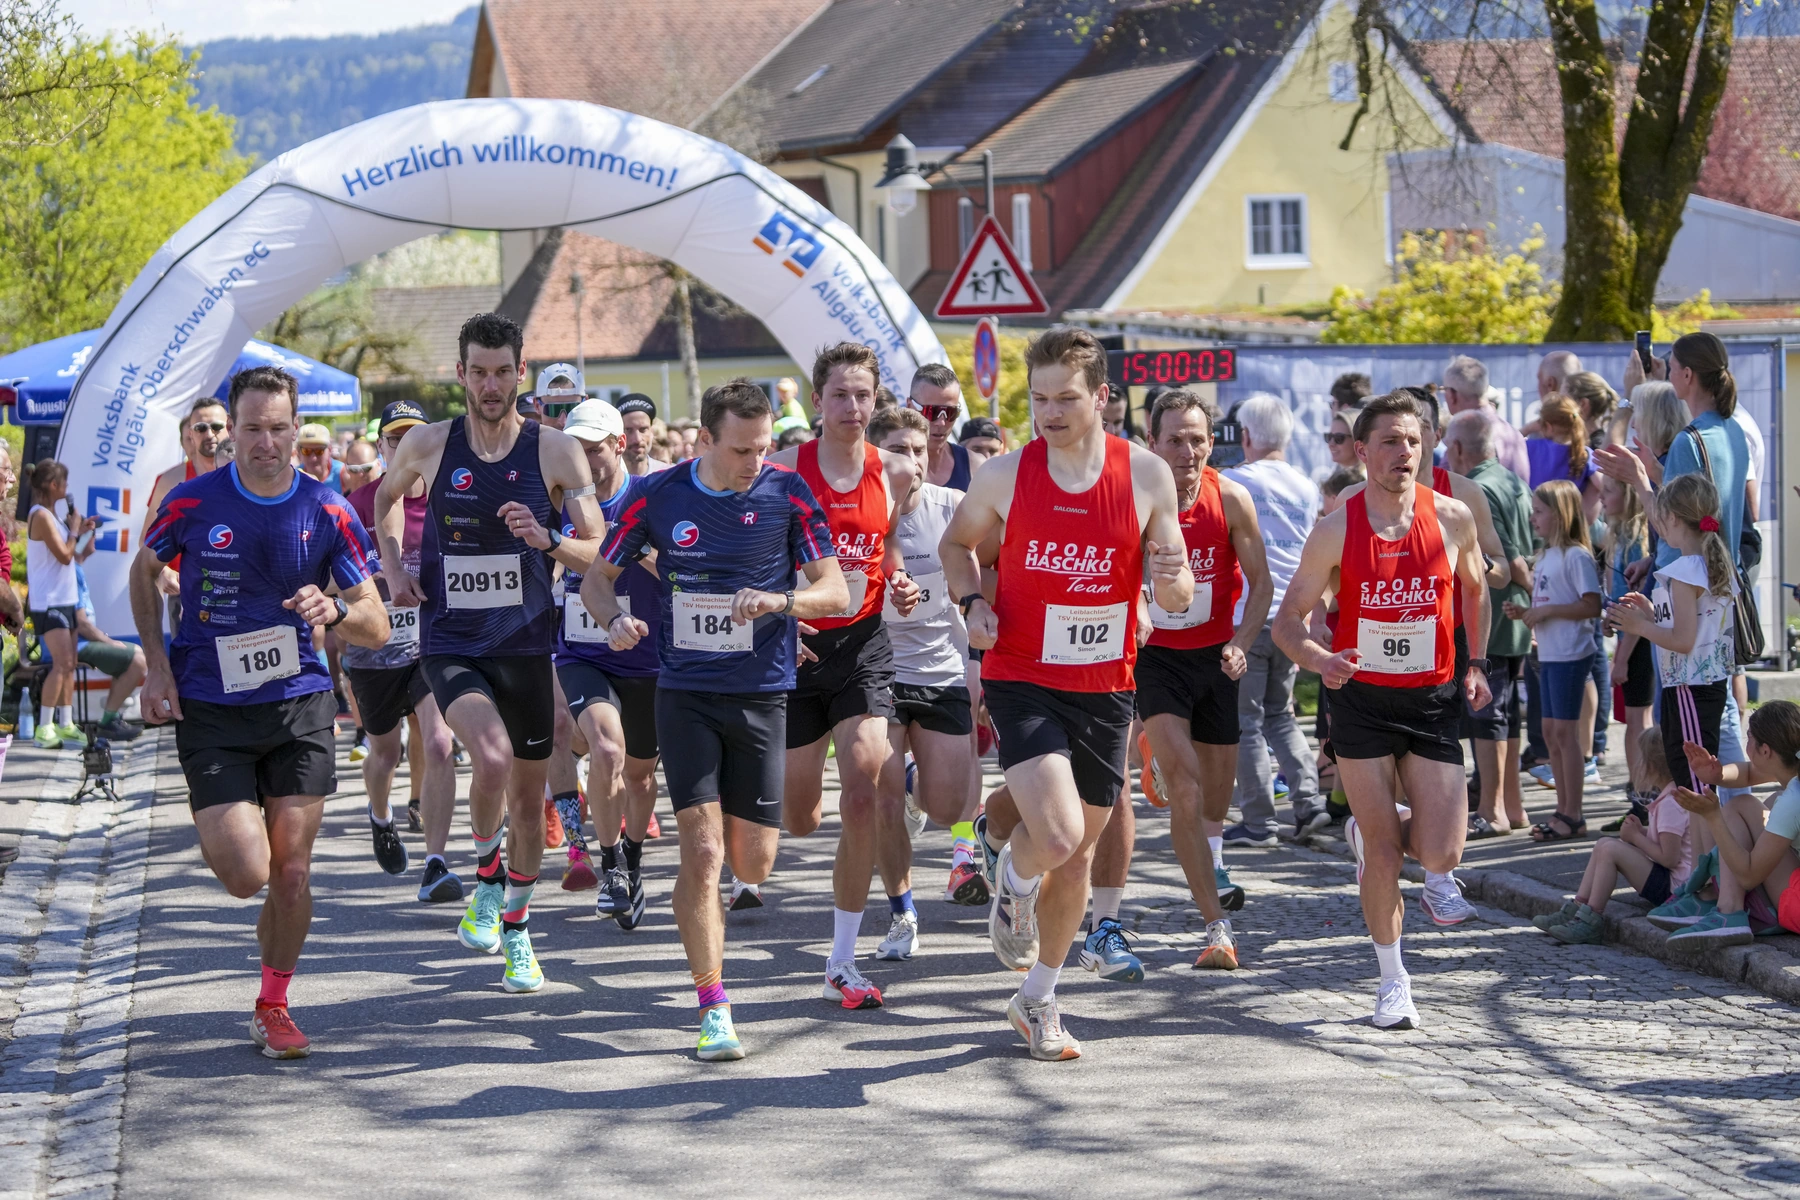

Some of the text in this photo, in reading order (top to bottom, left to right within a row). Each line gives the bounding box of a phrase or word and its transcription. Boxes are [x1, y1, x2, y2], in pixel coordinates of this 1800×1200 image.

[342, 134, 679, 197] Herzlich willkommen!
[833, 261, 905, 353] Volksbank
[116, 240, 271, 475] Allgäu-Oberschwaben eG
[1122, 349, 1234, 384] 15:00:03
[26, 398, 69, 417] Augusti
[92, 361, 141, 468] Volksbank
[1053, 505, 1088, 514] SALOMON
[830, 533, 879, 545] ORT
[834, 545, 875, 557] CHKO
[1027, 539, 1116, 559] SPORT
[840, 562, 870, 571] eam
[1025, 552, 1112, 573] HASCHKO
[447, 571, 519, 593] 20913
[1066, 576, 1113, 593] Team
[1360, 575, 1438, 593] SPORT
[1360, 589, 1437, 606] HASCHKO
[580, 611, 599, 628] 1
[1072, 614, 1119, 622] Hergensweiler
[1398, 607, 1442, 623] Team
[691, 614, 733, 635] 184
[236, 630, 275, 643] Leiblachlauf
[241, 634, 287, 649] Hergensweiler
[1067, 623, 1109, 645] 102
[1383, 638, 1410, 656] 96
[239, 647, 281, 674] 180
[1093, 653, 1109, 661] AOK
